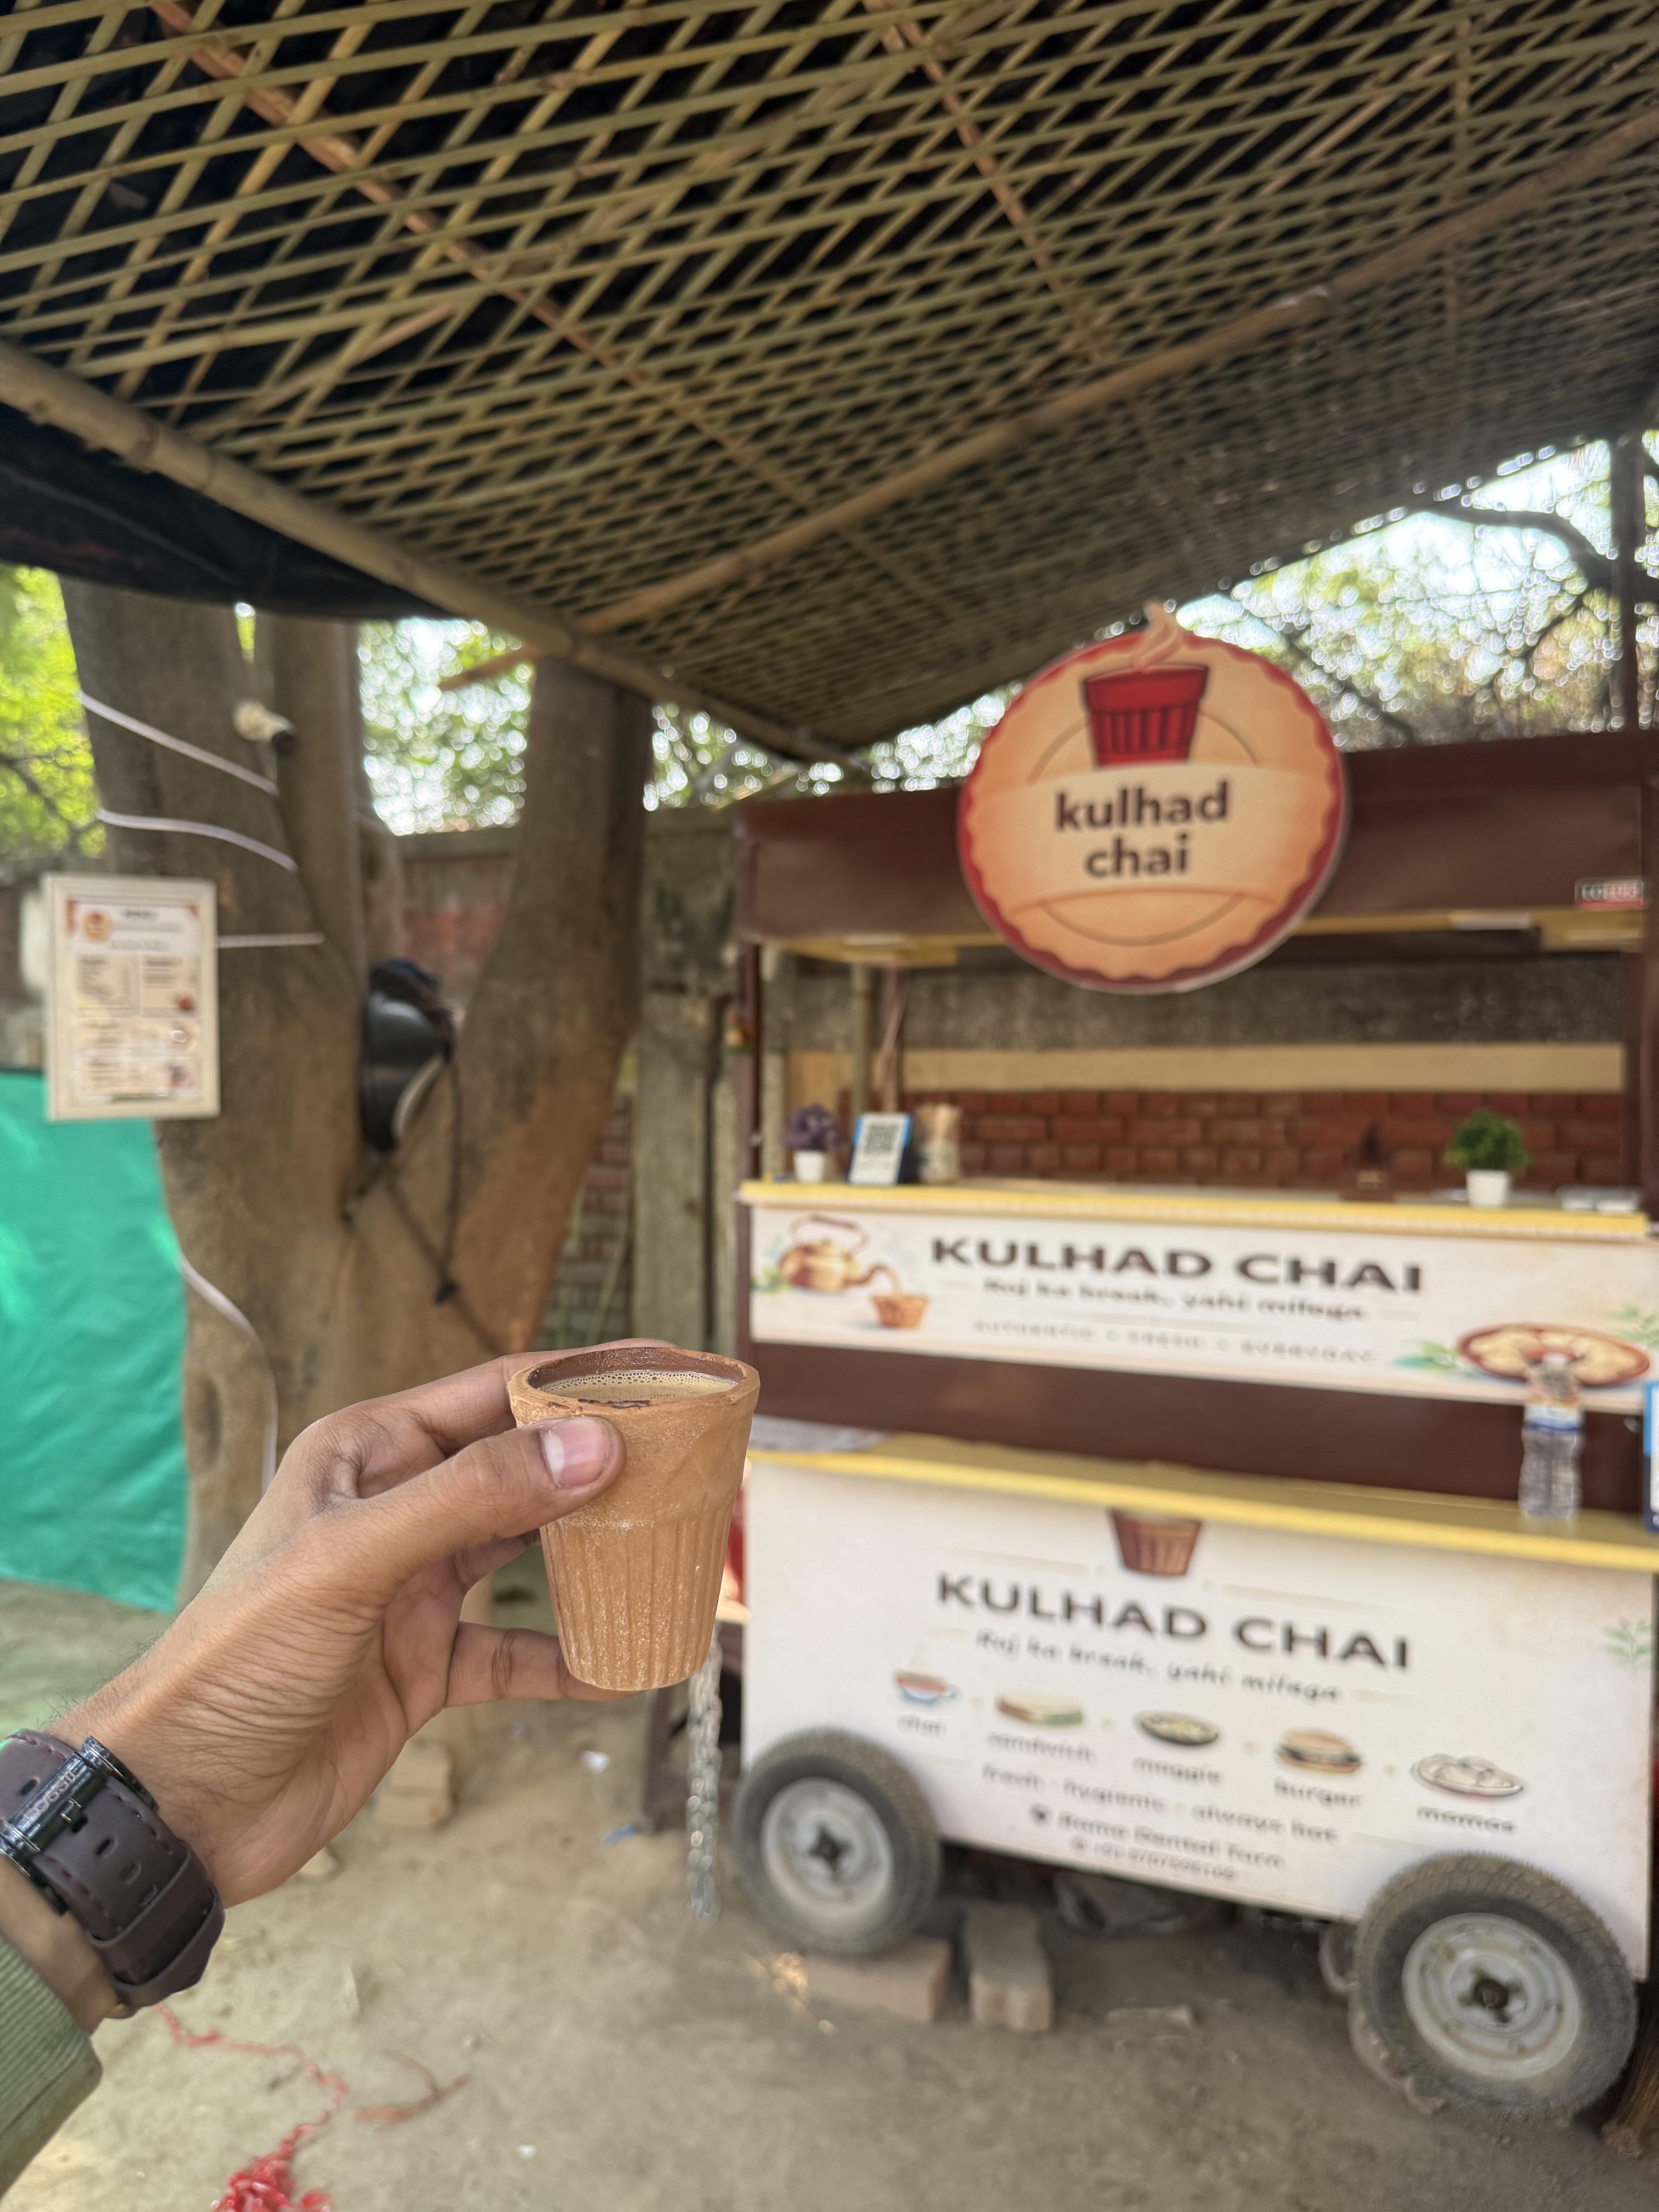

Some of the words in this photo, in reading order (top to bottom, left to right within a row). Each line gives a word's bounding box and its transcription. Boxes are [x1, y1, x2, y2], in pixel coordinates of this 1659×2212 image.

[1054, 780, 1230, 831] kulhad
[1085, 830, 1189, 877] chai
[931, 1237, 1211, 1278] KULHAD
[1235, 1253, 1421, 1292] CHAI
[938, 1572, 1207, 1638] KULHAD
[1234, 1616, 1408, 1670] CHAI
[1166, 1662, 1231, 1685] yahi
[1273, 1778, 1362, 1807] burger
[1192, 1804, 1285, 1834] always
[1291, 1817, 1338, 1842] hot
[1416, 1805, 1517, 1834] momos
